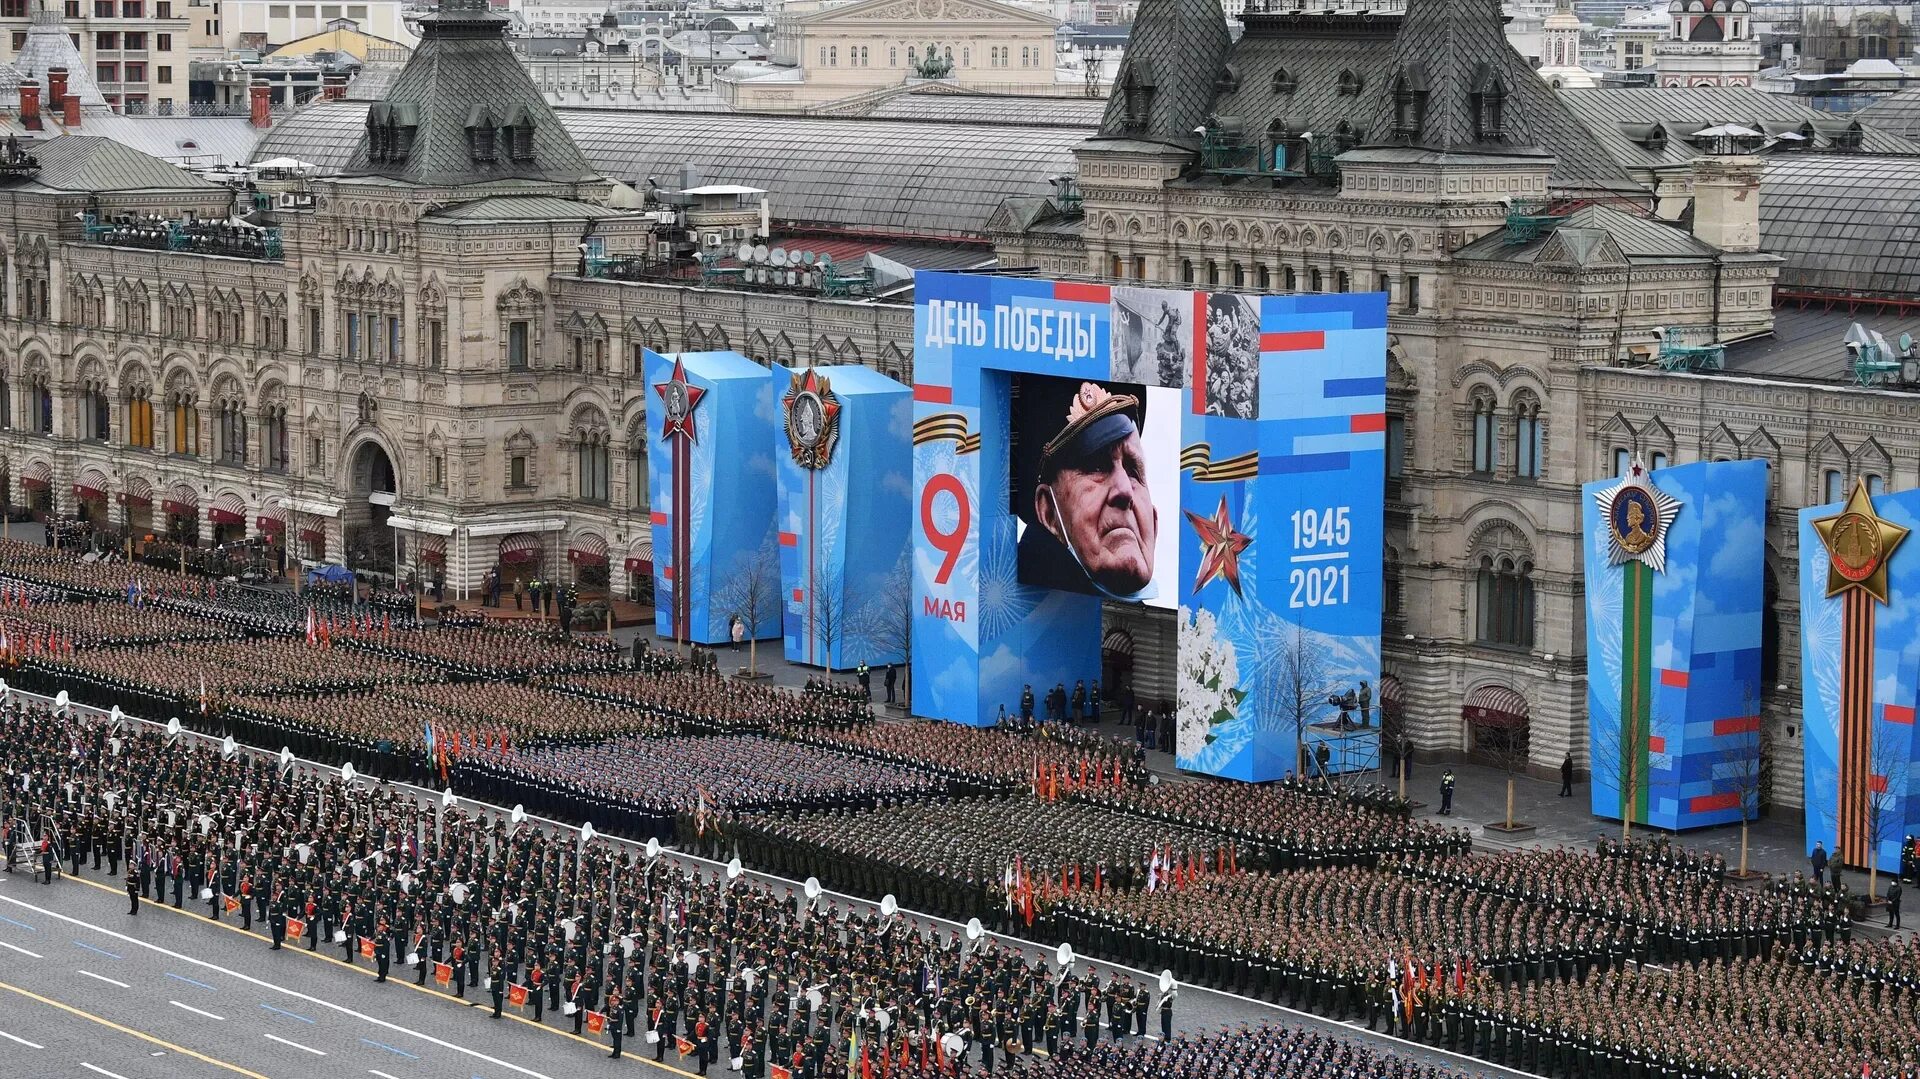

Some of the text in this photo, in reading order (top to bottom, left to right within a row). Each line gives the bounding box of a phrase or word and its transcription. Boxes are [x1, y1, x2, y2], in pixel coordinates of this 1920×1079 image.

[925, 298, 1095, 362] ДЕНЬ ПОБЕДЫ
[921, 473, 971, 585] 9
[1290, 506, 1351, 550] 1945
[1289, 565, 1349, 609] 2021
[1839, 562, 1872, 577] СЛАВА
[924, 596, 966, 623] МАЯ
